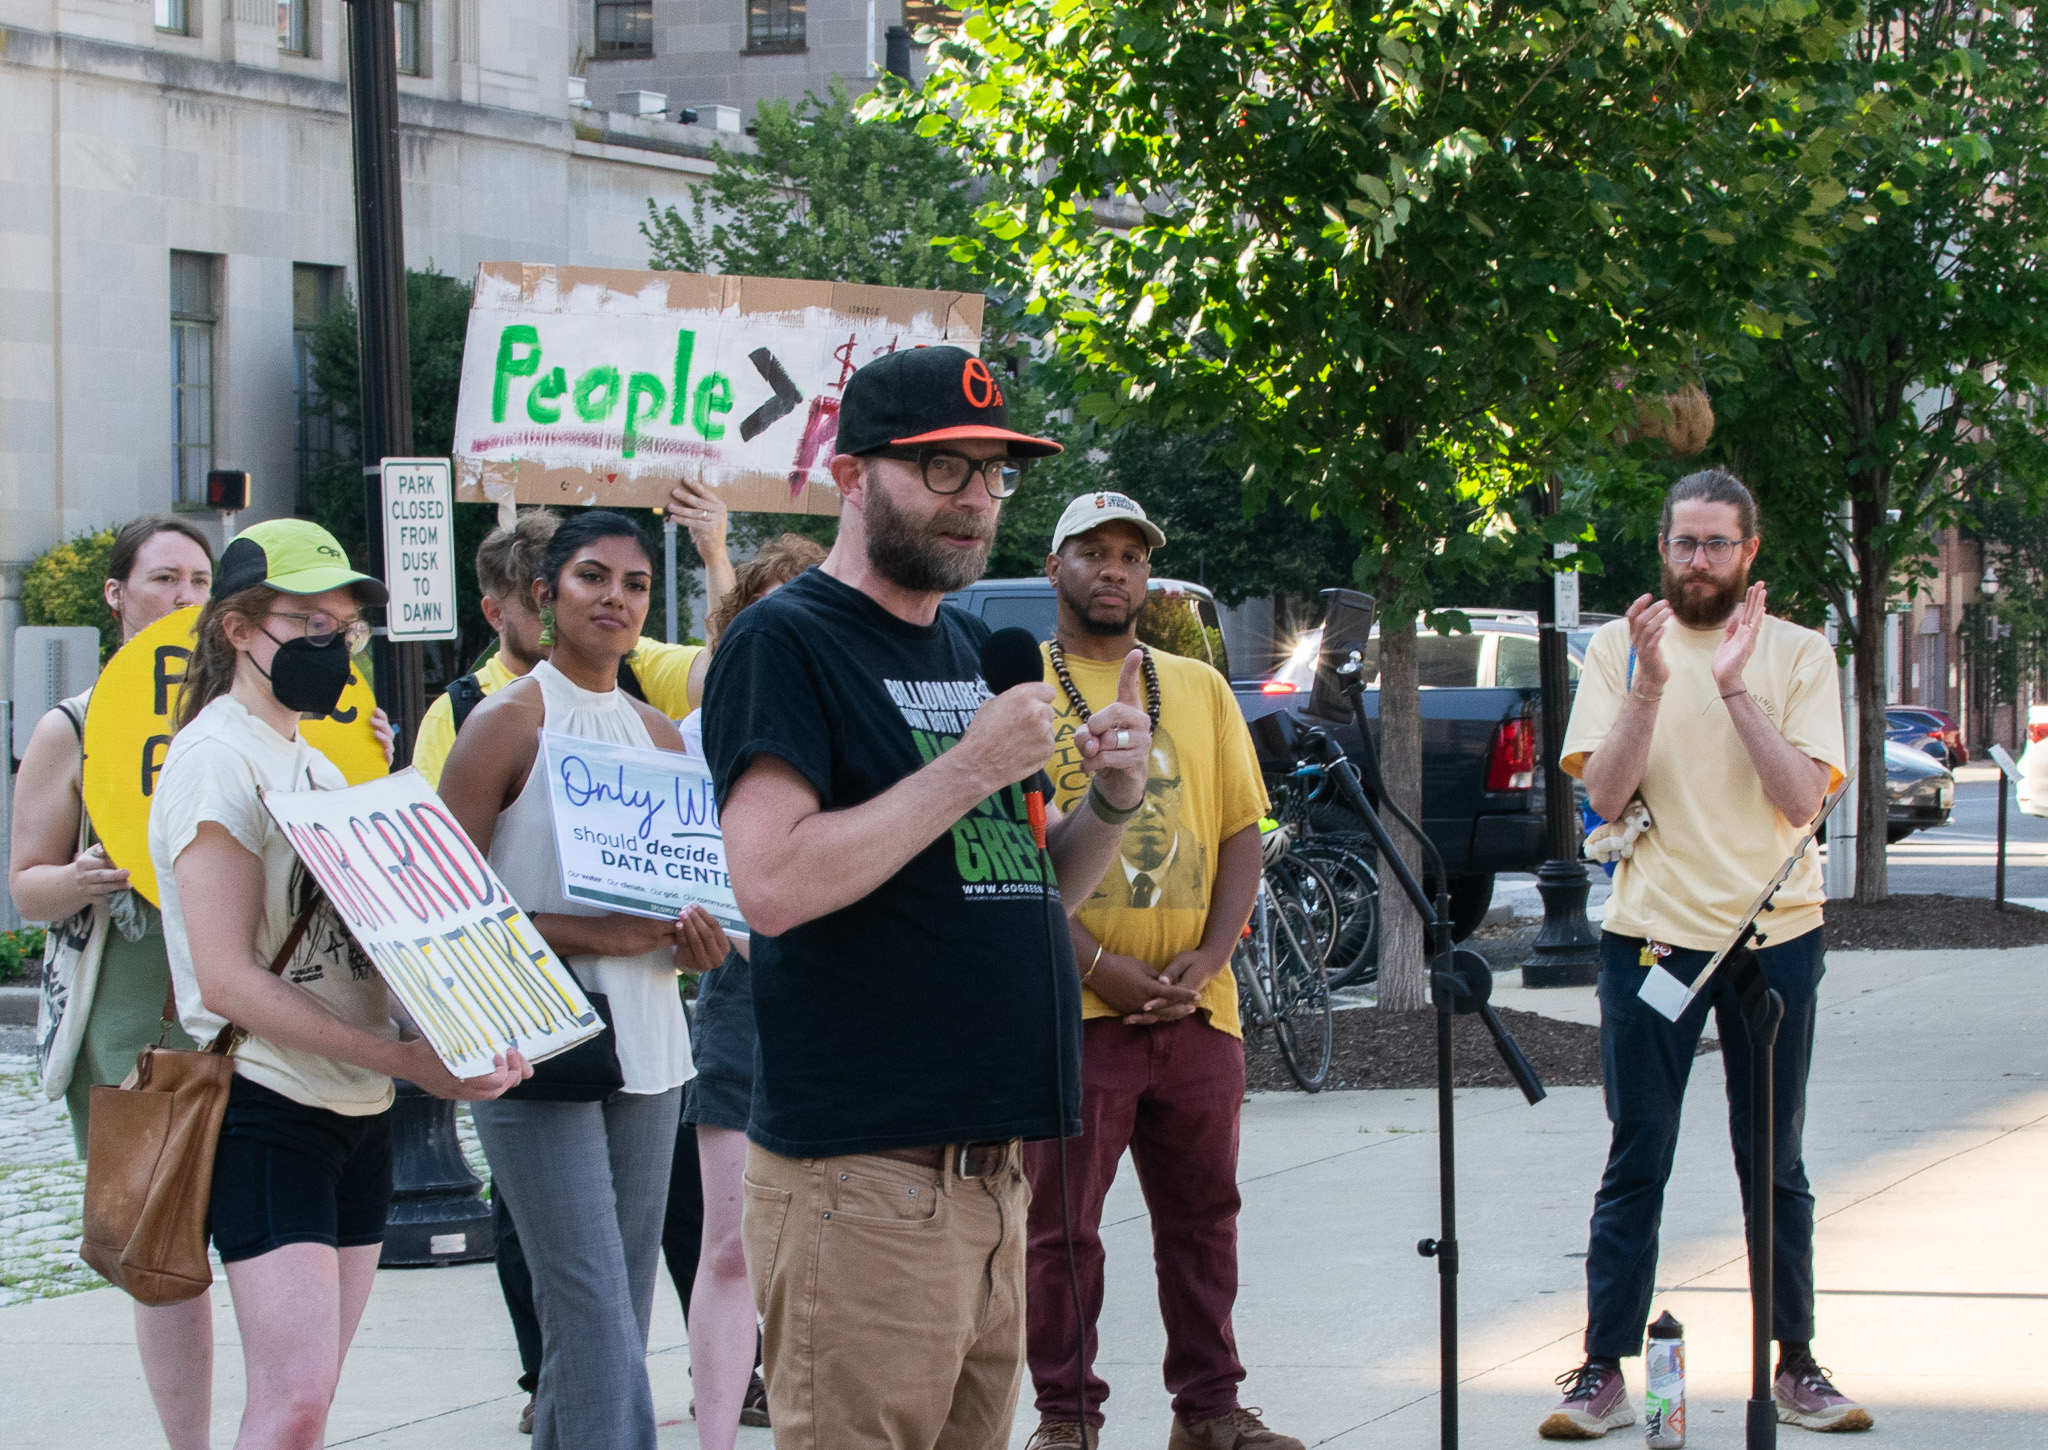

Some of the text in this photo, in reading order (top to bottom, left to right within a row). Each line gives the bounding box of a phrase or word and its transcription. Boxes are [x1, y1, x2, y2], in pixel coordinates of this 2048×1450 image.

[492, 325, 735, 458] People
[399, 475, 435, 495] PARK
[392, 501, 444, 520] CLOSED
[400, 526, 438, 545] FROM
[402, 552, 438, 571] DUSK
[413, 577, 430, 596] TO
[403, 602, 442, 622] DAWN
[925, 711, 962, 735] BOTH
[561, 755, 665, 840] Only
[573, 825, 719, 865] should decide
[601, 850, 732, 889] DATA CENTE
[414, 905, 597, 1055] FUTURE
